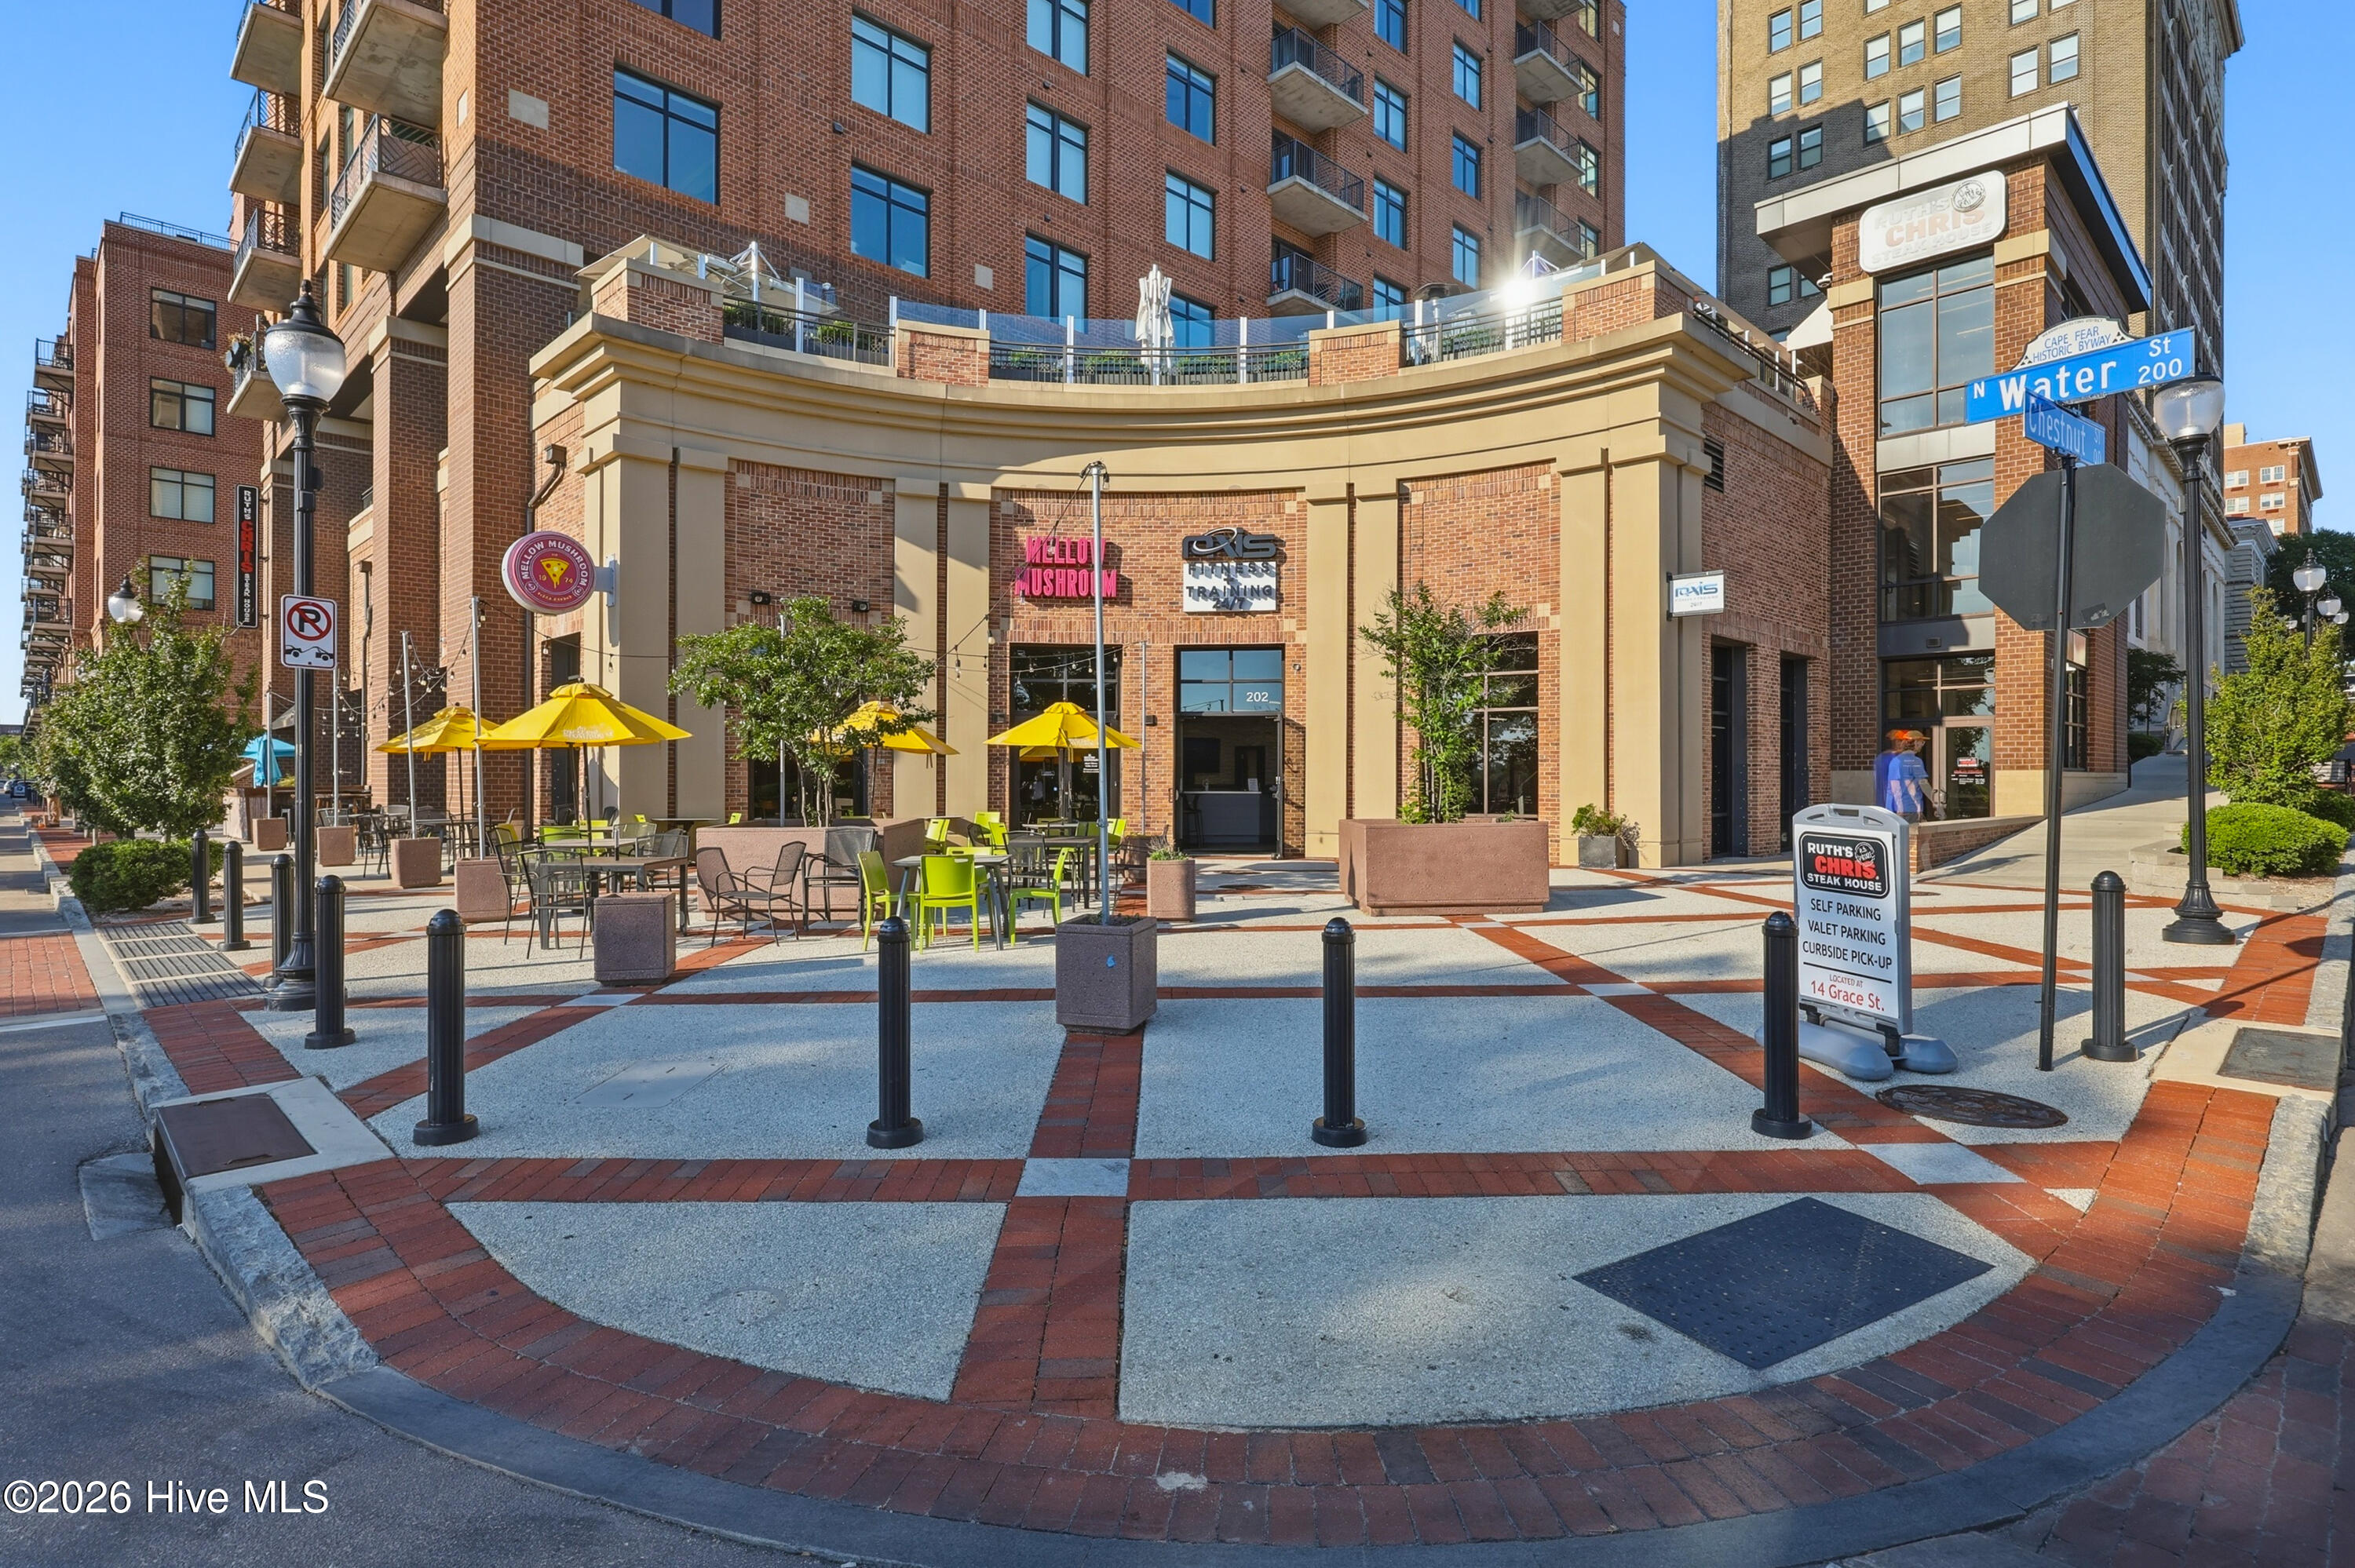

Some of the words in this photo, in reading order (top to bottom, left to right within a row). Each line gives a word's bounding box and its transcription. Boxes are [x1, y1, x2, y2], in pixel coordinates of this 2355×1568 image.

[1885, 210, 1985, 247] CHRIS
[2032, 343, 2072, 363] HISTORIC
[2078, 334, 2112, 352] BYWAY
[2044, 333, 2069, 349] CAPE
[2075, 326, 2099, 341] FEAR
[1973, 381, 1985, 399] N
[1999, 360, 2117, 411] Water
[2149, 336, 2171, 358] St
[2138, 358, 2183, 385] 200
[2028, 396, 2086, 456] Chestnut
[520, 541, 545, 579] MELLOW
[548, 540, 589, 587] MUSHROOM
[1188, 562, 1272, 575] FITNESS
[1186, 585, 1273, 597] TRAINING
[1246, 691, 1269, 702] 202
[1807, 842, 1853, 858] RUTH'S
[1814, 855, 1877, 879] CHRIS
[1807, 873, 1841, 886] STEAK
[1844, 877, 1882, 892] HOUSE
[1810, 898, 1833, 913] SELF
[1836, 902, 1882, 921] PARKING
[1808, 919, 1838, 936] VALET
[1841, 925, 1886, 946] PARKING
[1802, 941, 1849, 961] CURBSIDE
[1851, 950, 1893, 970] PICK-UP
[1829, 974, 1855, 986] LOCATED
[1810, 979, 1825, 996] 14
[1828, 983, 1864, 1005] Grace
[1868, 992, 1885, 1012] St.
